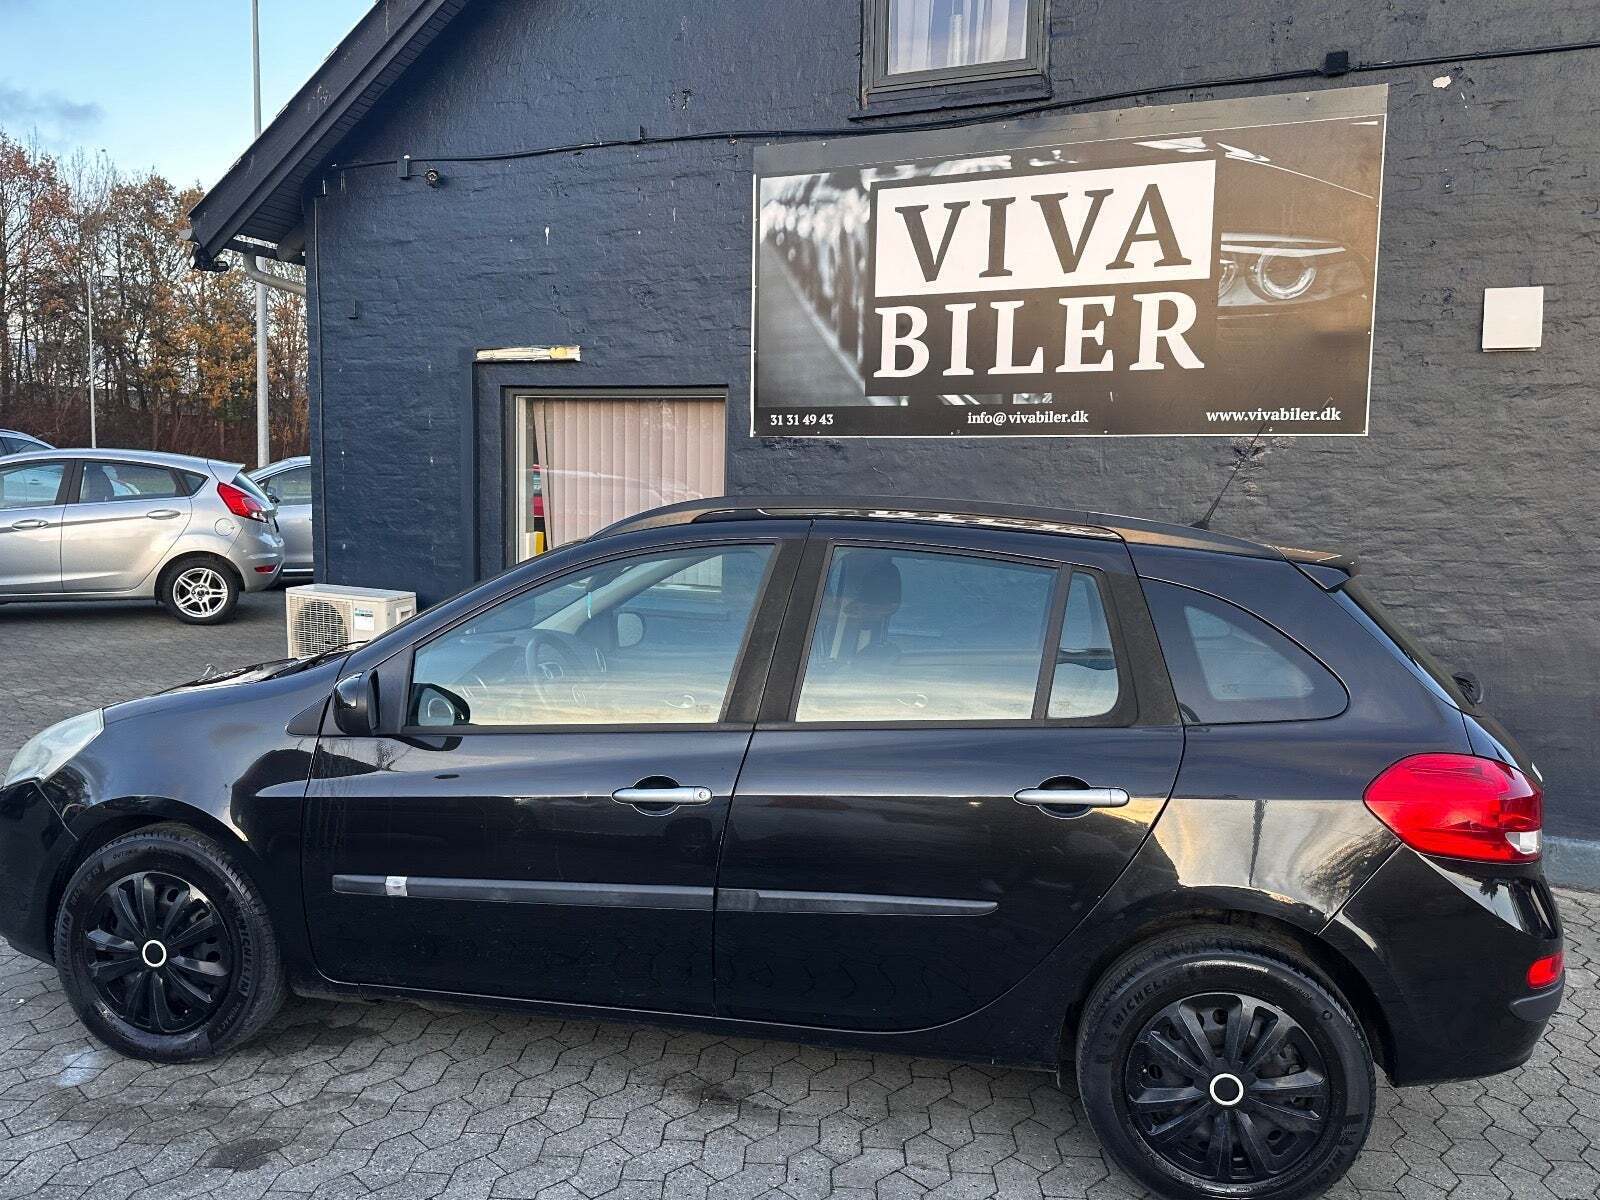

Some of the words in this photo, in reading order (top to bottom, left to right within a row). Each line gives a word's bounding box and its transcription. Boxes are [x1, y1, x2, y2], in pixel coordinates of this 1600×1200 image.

[895, 184, 1191, 282] VIVA
[874, 292, 1205, 378] BILER
[770, 414, 783, 426] 31
[786, 414, 800, 426] 31
[802, 413, 817, 426] 49
[818, 413, 834, 426] 43
[967, 410, 1089, 426] info@vivabiler.dk
[1205, 406, 1342, 422] www.vivabiler.dk
